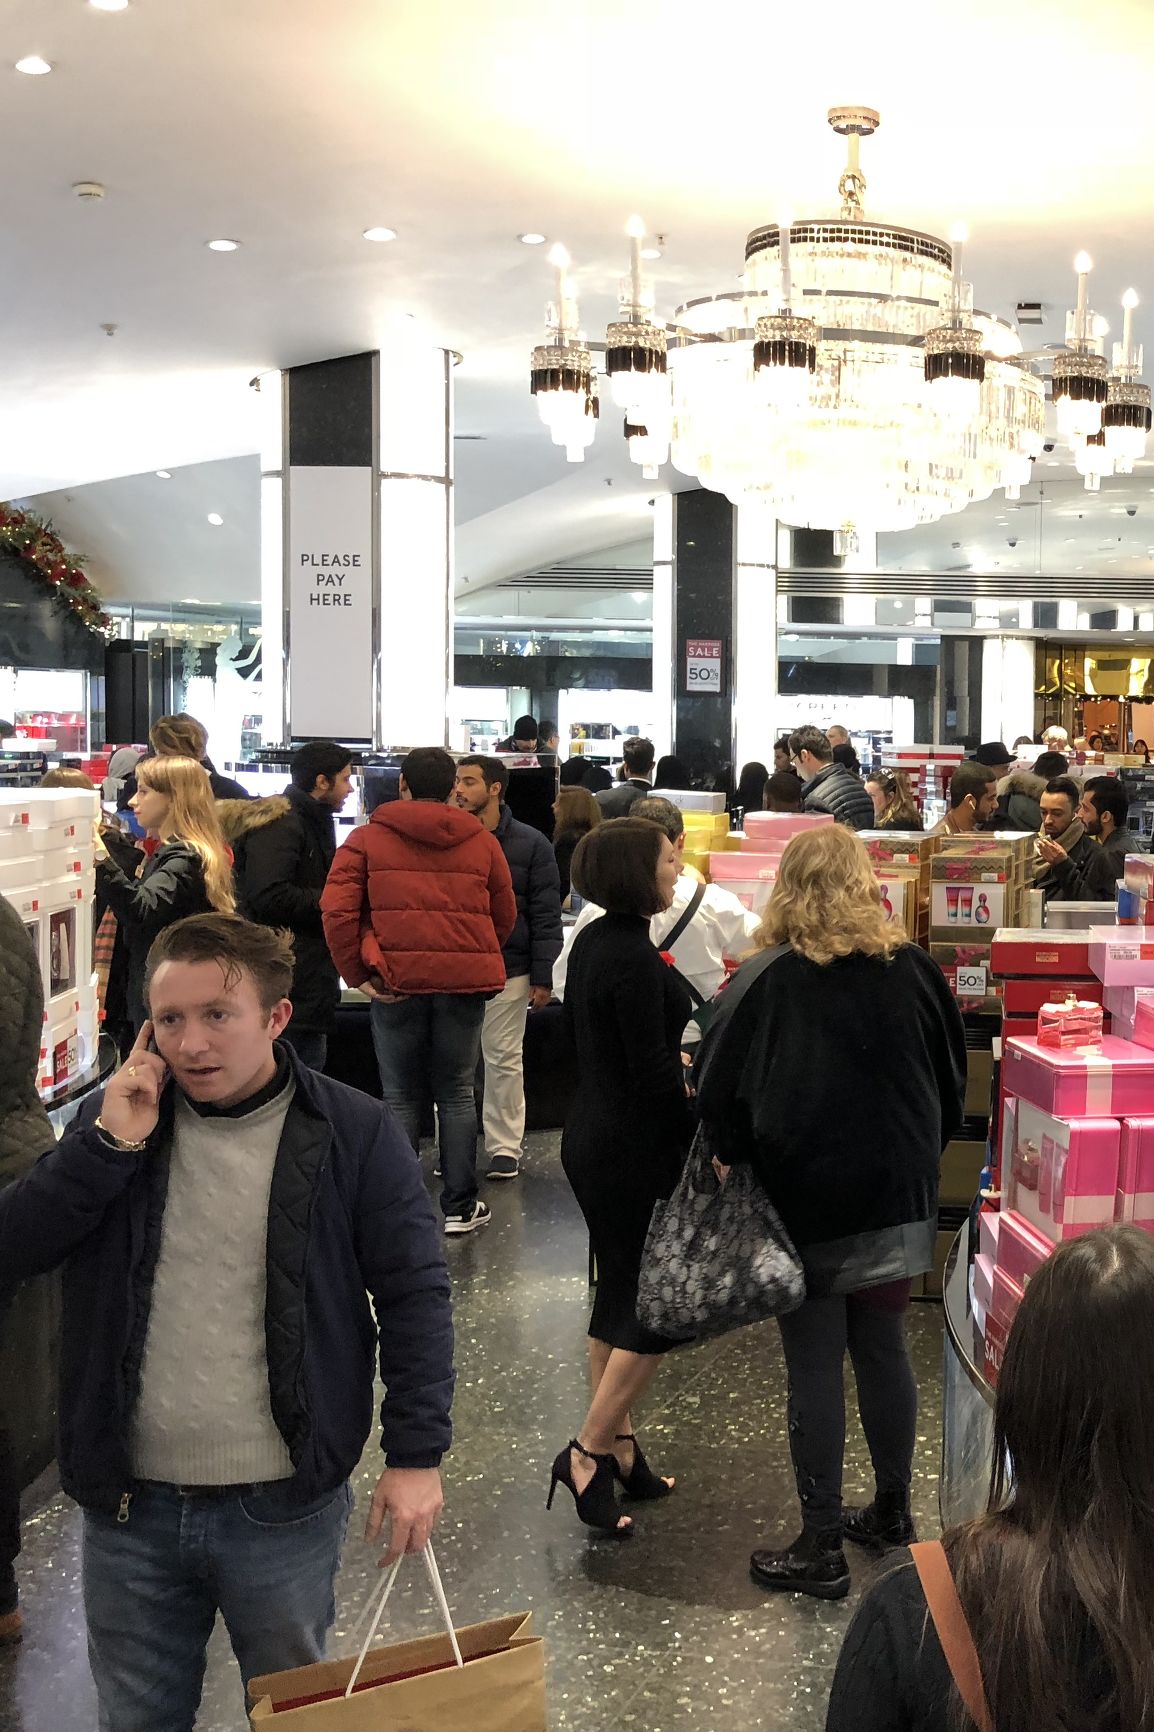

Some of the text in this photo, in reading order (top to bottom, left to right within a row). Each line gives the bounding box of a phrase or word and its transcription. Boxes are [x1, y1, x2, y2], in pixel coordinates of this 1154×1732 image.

[301, 554, 361, 567] PLEASE
[316, 573, 345, 586] PAY
[310, 593, 352, 606] HERE
[689, 647, 719, 656] SALE
[958, 975, 984, 987] 50%
